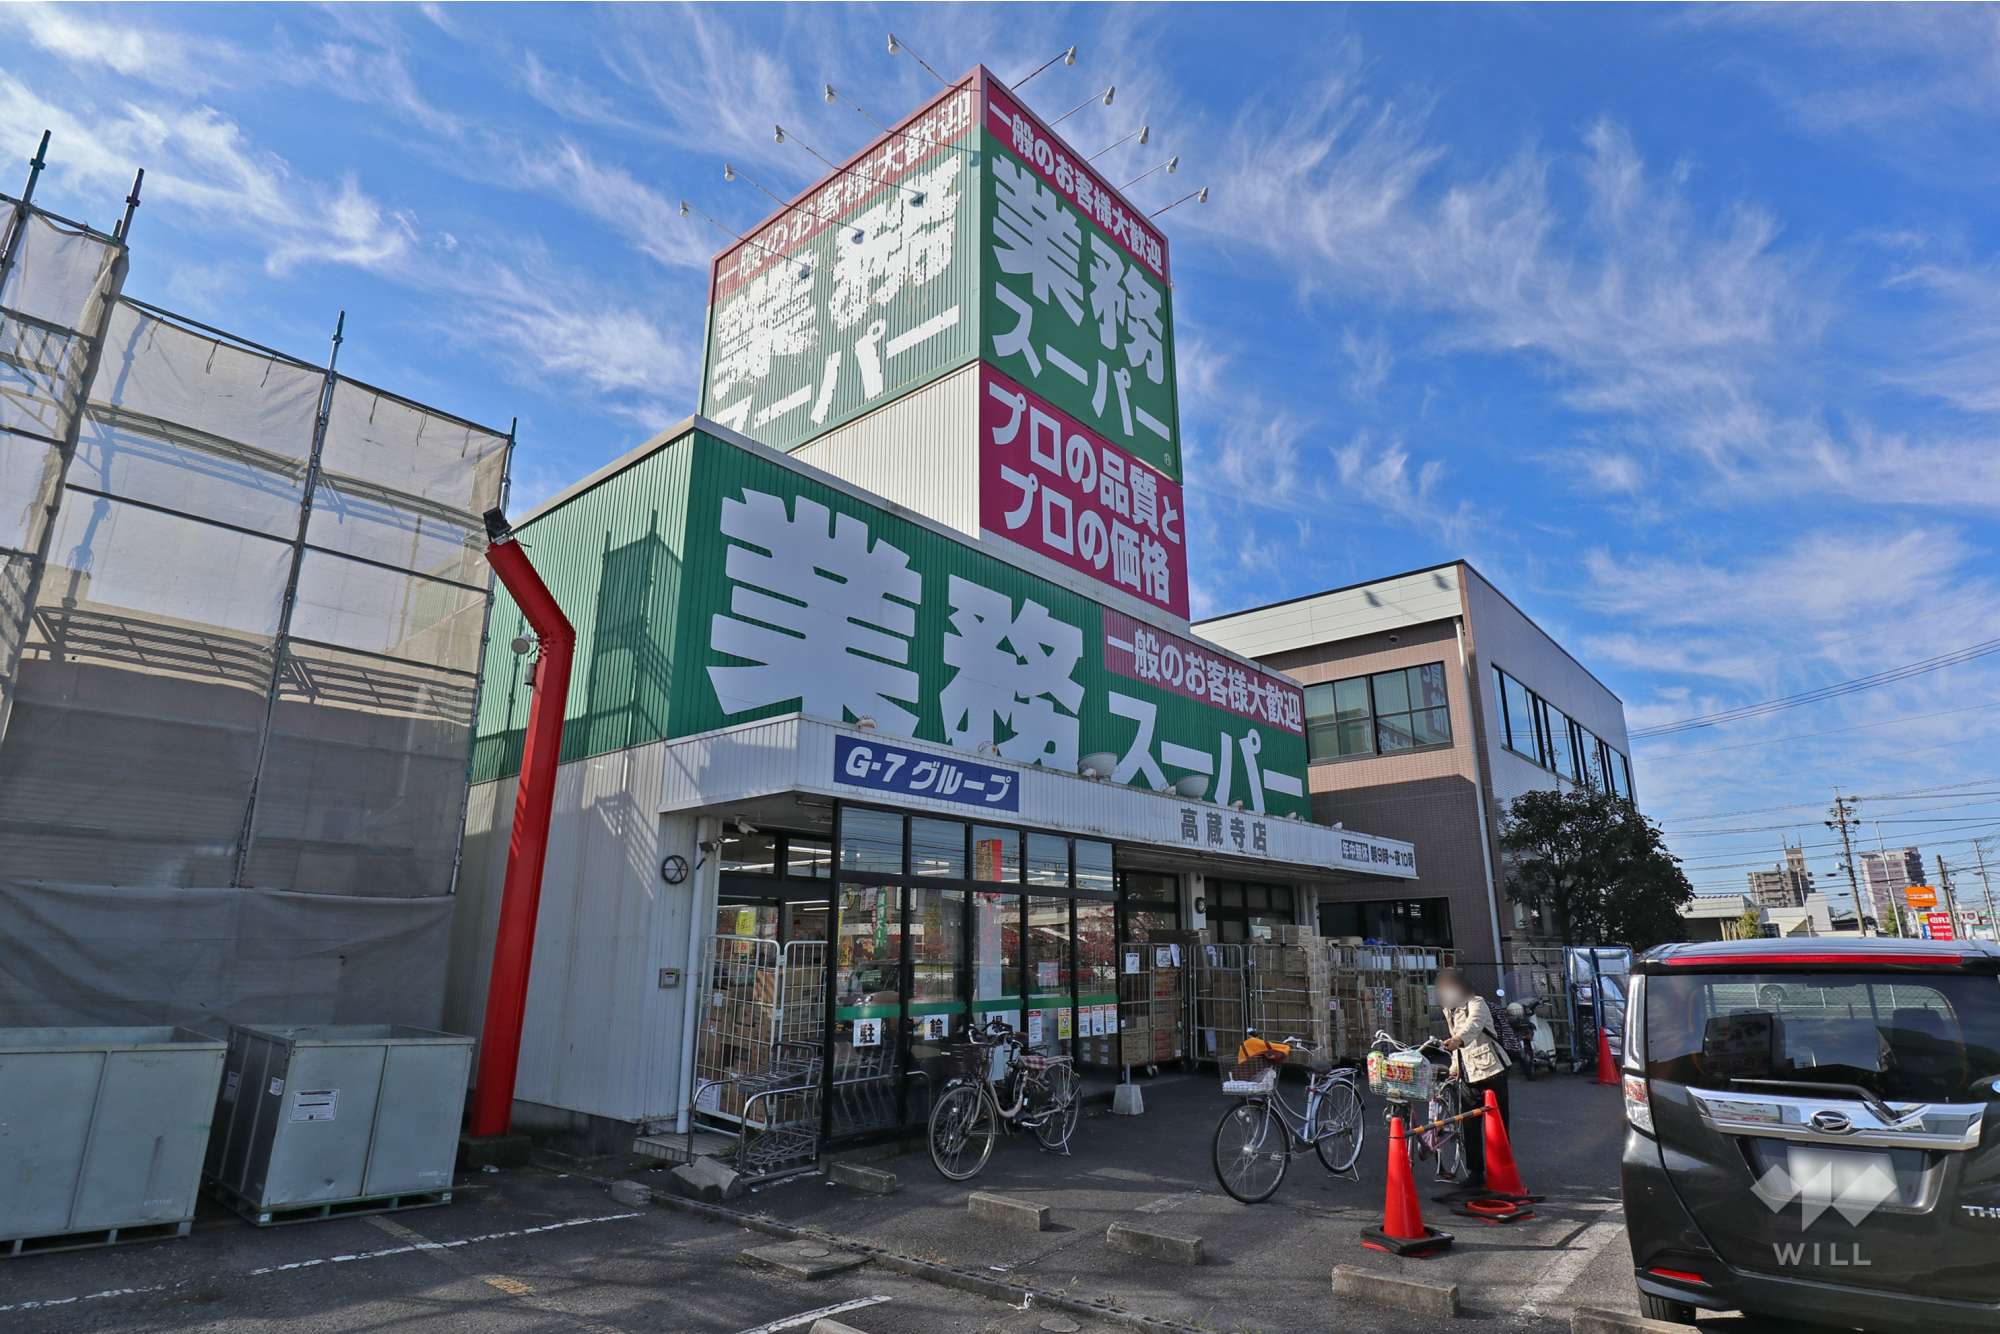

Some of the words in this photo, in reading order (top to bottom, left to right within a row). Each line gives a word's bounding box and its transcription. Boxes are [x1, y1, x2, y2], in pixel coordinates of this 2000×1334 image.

[989, 102, 1163, 276] 一般のお客様大歓迎
[992, 153, 1164, 385] 業務
[992, 281, 1170, 441] スーパー
[989, 381, 1180, 545] プロの品質と
[1000, 464, 1170, 605] プロの価格
[1106, 629, 1304, 733] 一般のお客様大歓迎
[845, 746, 907, 782] G-7
[909, 760, 1013, 802] グループ
[1180, 808, 1268, 853] 高蔵寺店
[1961, 1205, 2000, 1218] TH
